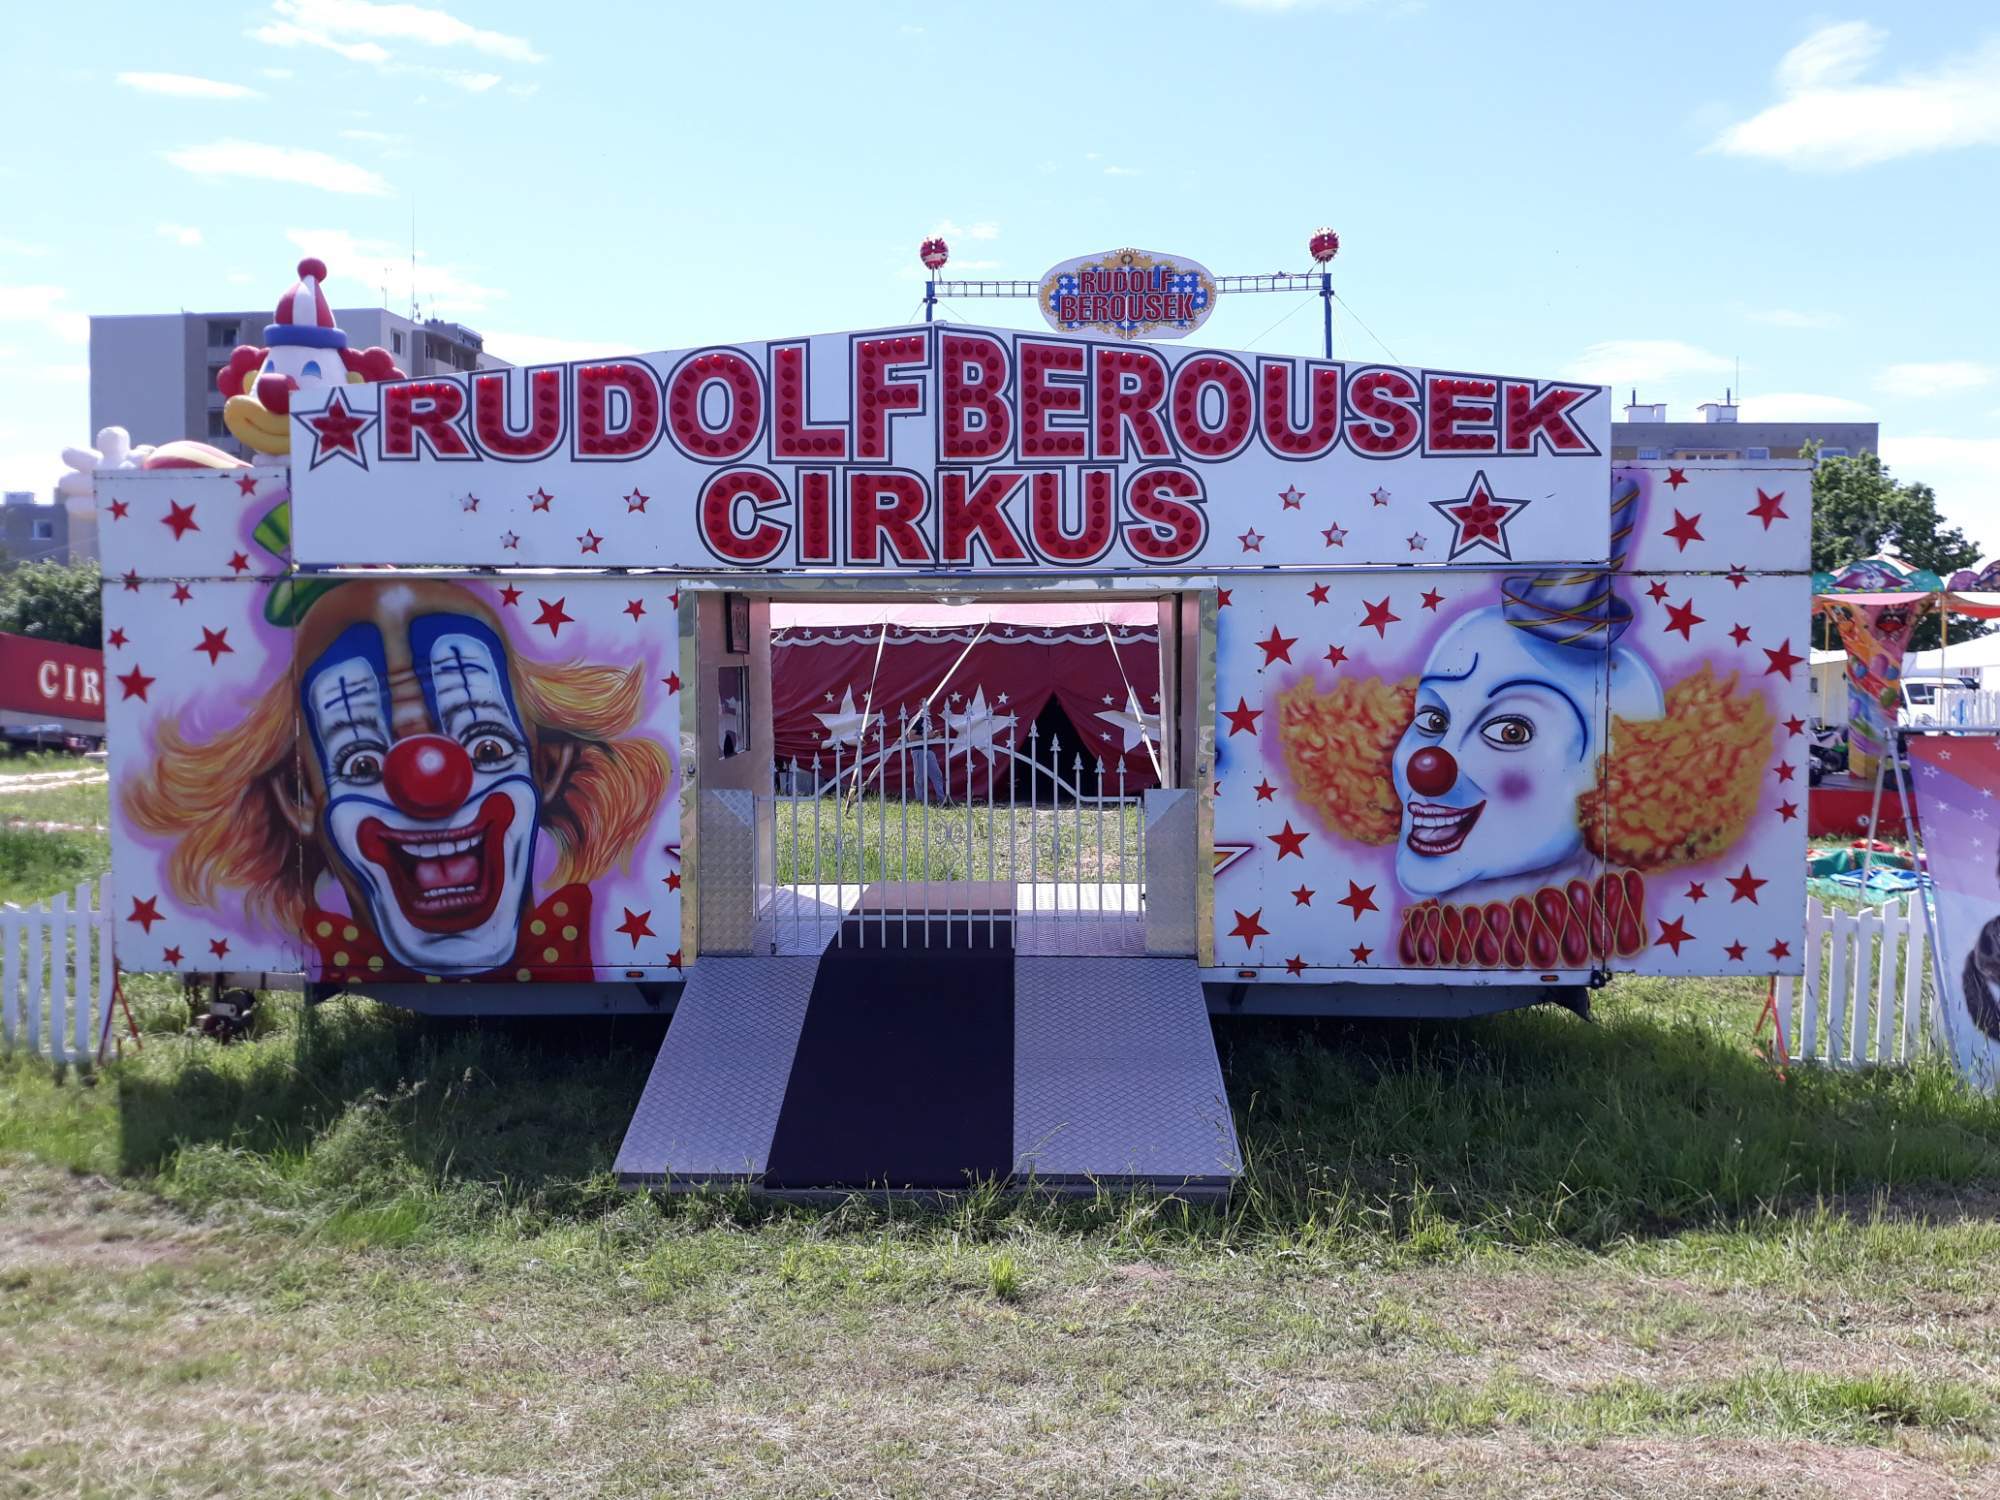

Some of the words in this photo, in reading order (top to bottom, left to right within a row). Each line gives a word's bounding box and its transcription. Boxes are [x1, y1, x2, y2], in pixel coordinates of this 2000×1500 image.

[1059, 293, 1195, 322] BEROUSEK
[1079, 269, 1175, 294] RUDOLF
[377, 326, 936, 465] RUDOLF
[937, 327, 1602, 463] BEROUSEK
[696, 463, 1210, 567] CIRKUS
